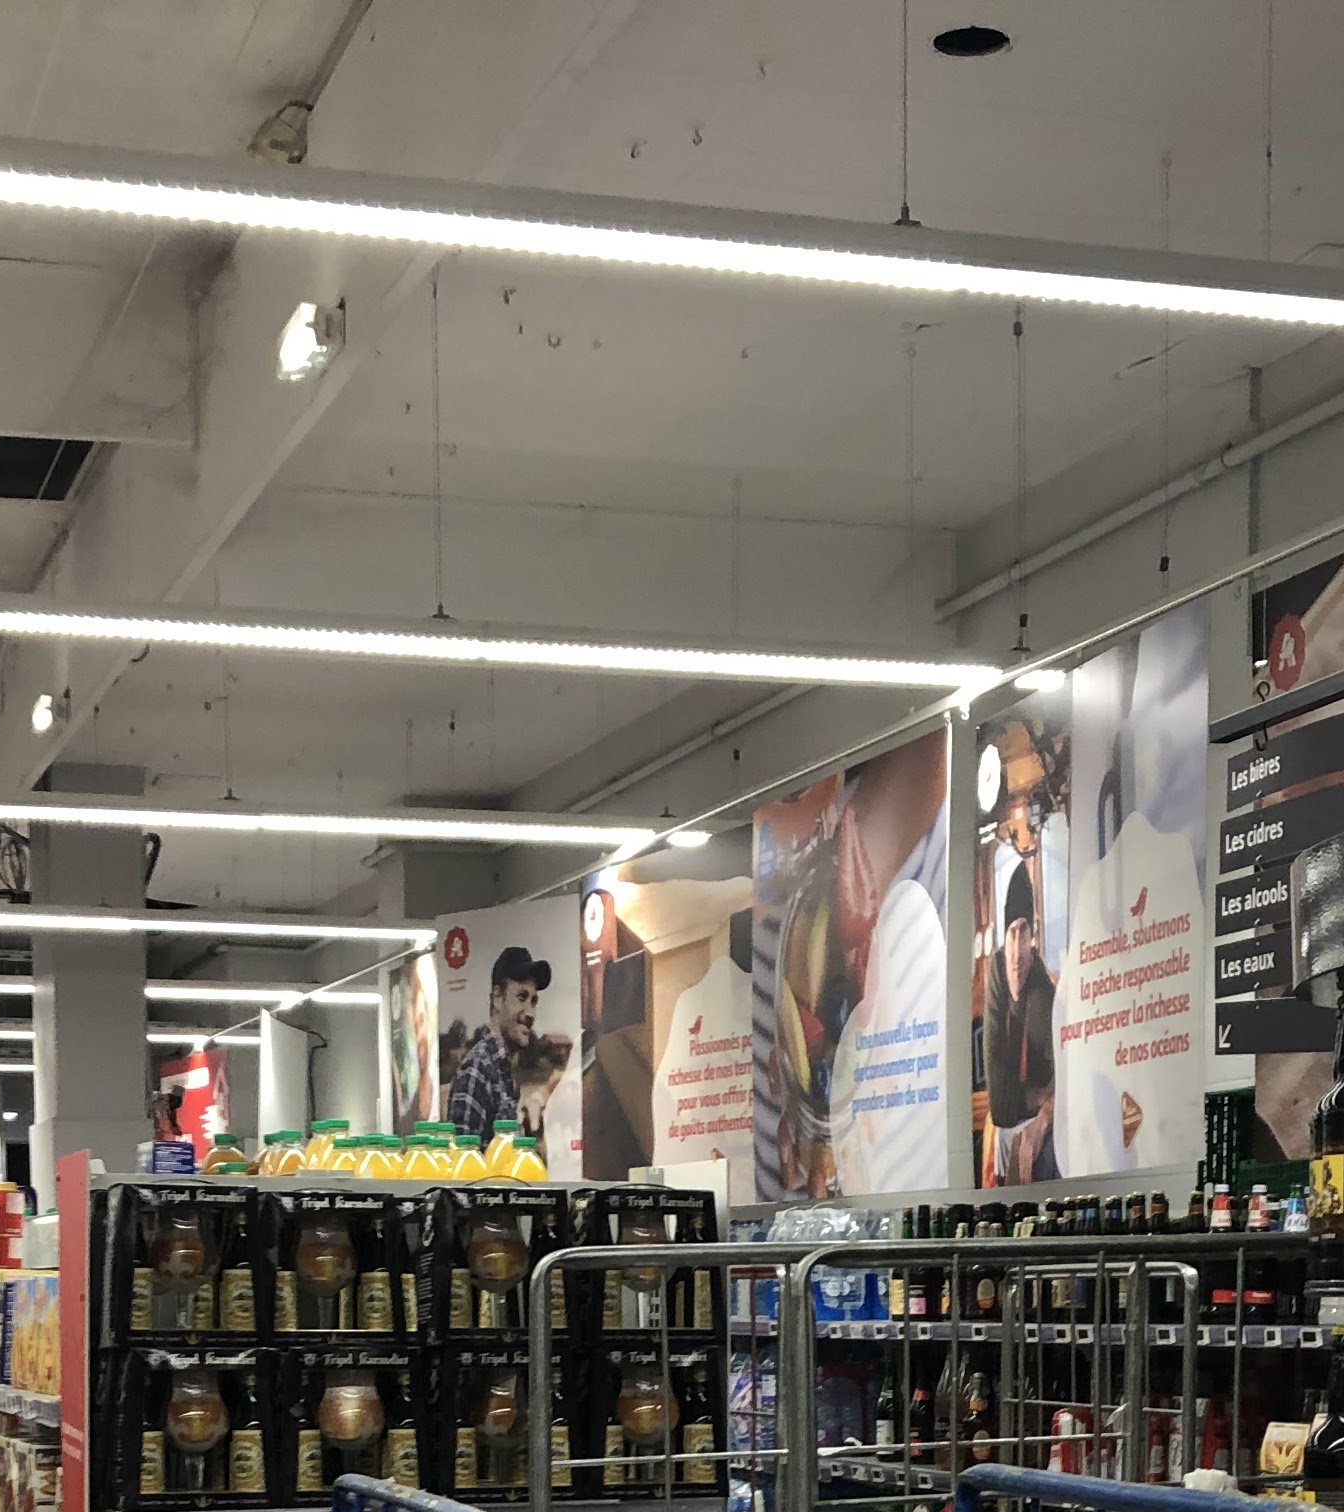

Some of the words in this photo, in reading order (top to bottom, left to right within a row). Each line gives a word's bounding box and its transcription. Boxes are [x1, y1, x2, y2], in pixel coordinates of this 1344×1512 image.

[1232, 767, 1248, 792] Les
[1249, 753, 1281, 788] bières
[1225, 833, 1247, 854] Les
[1249, 820, 1284, 848] cidres
[1221, 893, 1243, 917] Les
[1245, 881, 1288, 911] alcools
[1123, 952, 1191, 994] responsable
[1221, 957, 1241, 979] Les
[1244, 950, 1275, 975] eaux
[1060, 1021, 1082, 1046] pour
[1084, 1006, 1130, 1043] préserver
[1144, 992, 1190, 1022] richesse
[1116, 1044, 1128, 1068] de
[1130, 1044, 1149, 1063] nos
[1151, 1030, 1190, 1061] océans
[668, 1069, 702, 1087] richesse
[704, 1068, 714, 1081] de
[677, 1097, 699, 1116] pour
[700, 1095, 720, 1109] vous
[722, 1089, 747, 1107] offrir
[668, 1125, 679, 1140] de
[680, 1120, 705, 1143] goûts
